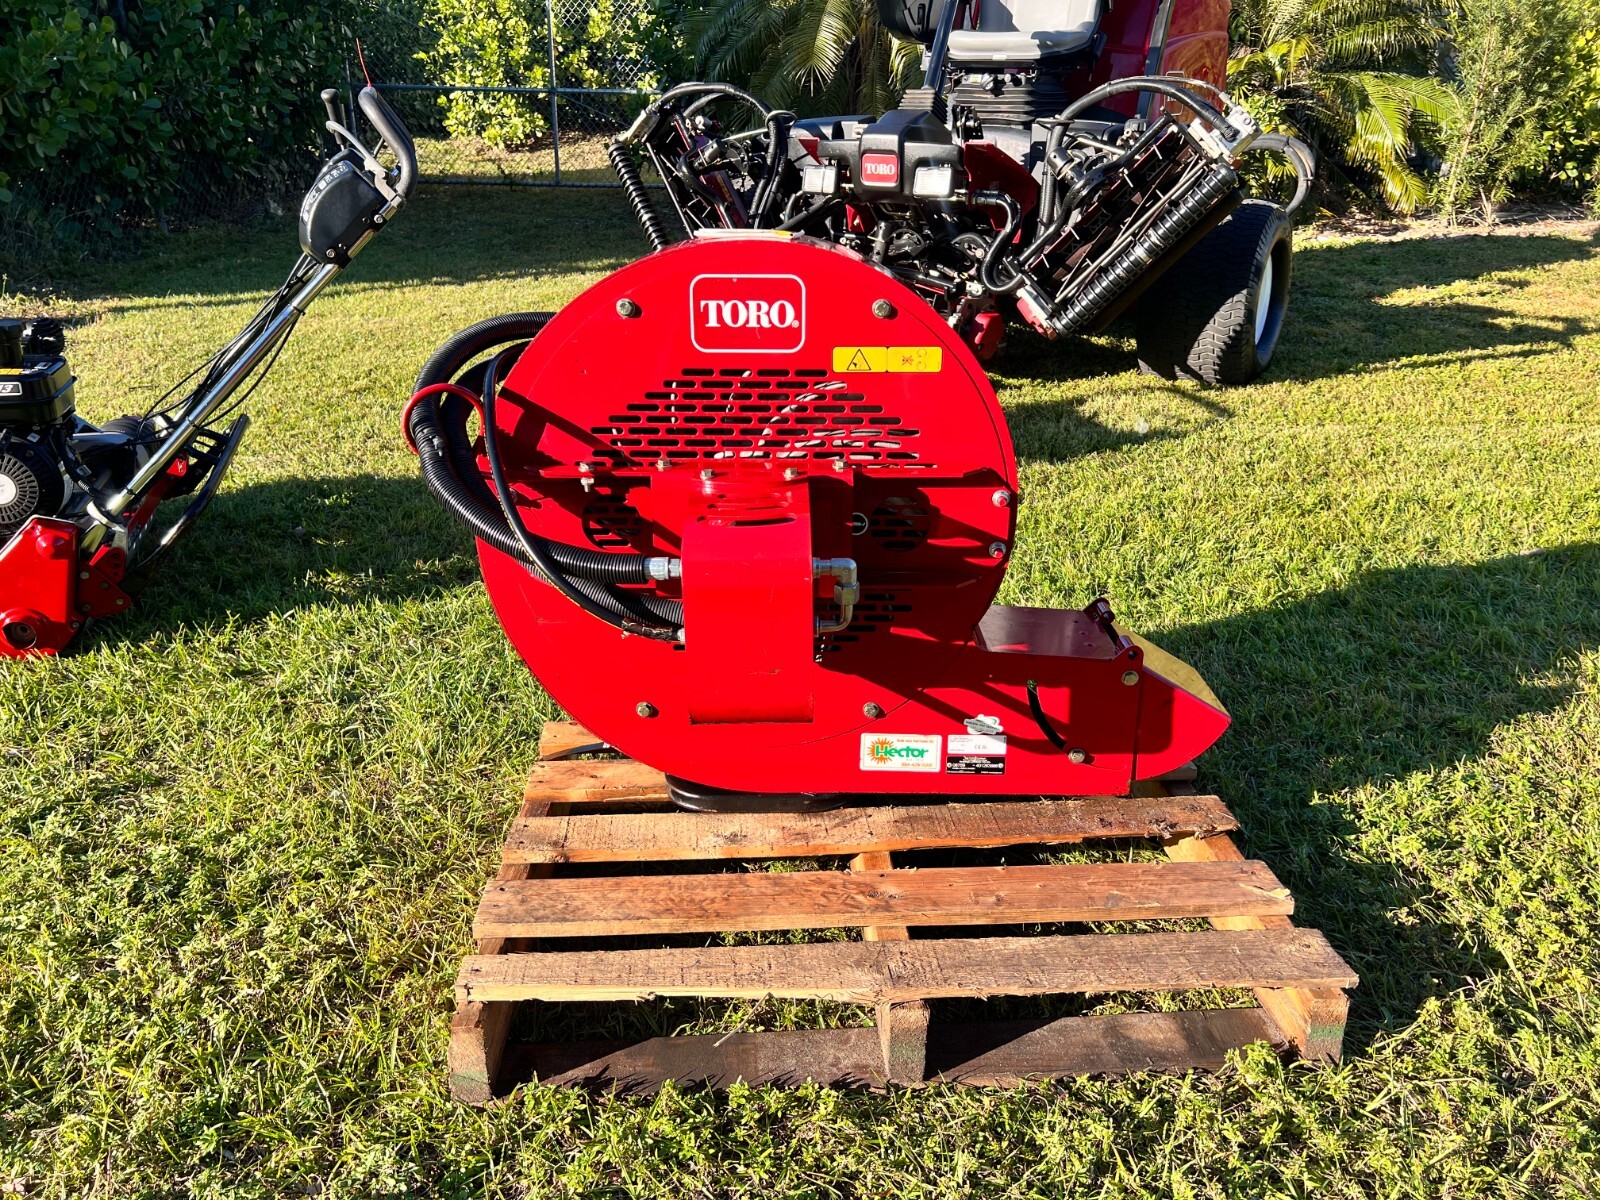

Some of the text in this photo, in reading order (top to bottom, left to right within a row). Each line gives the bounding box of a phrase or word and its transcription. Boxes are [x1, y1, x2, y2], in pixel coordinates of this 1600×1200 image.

[864, 163, 895, 175] TORO
[700, 300, 796, 328] TORO
[875, 745, 929, 758] Hector
